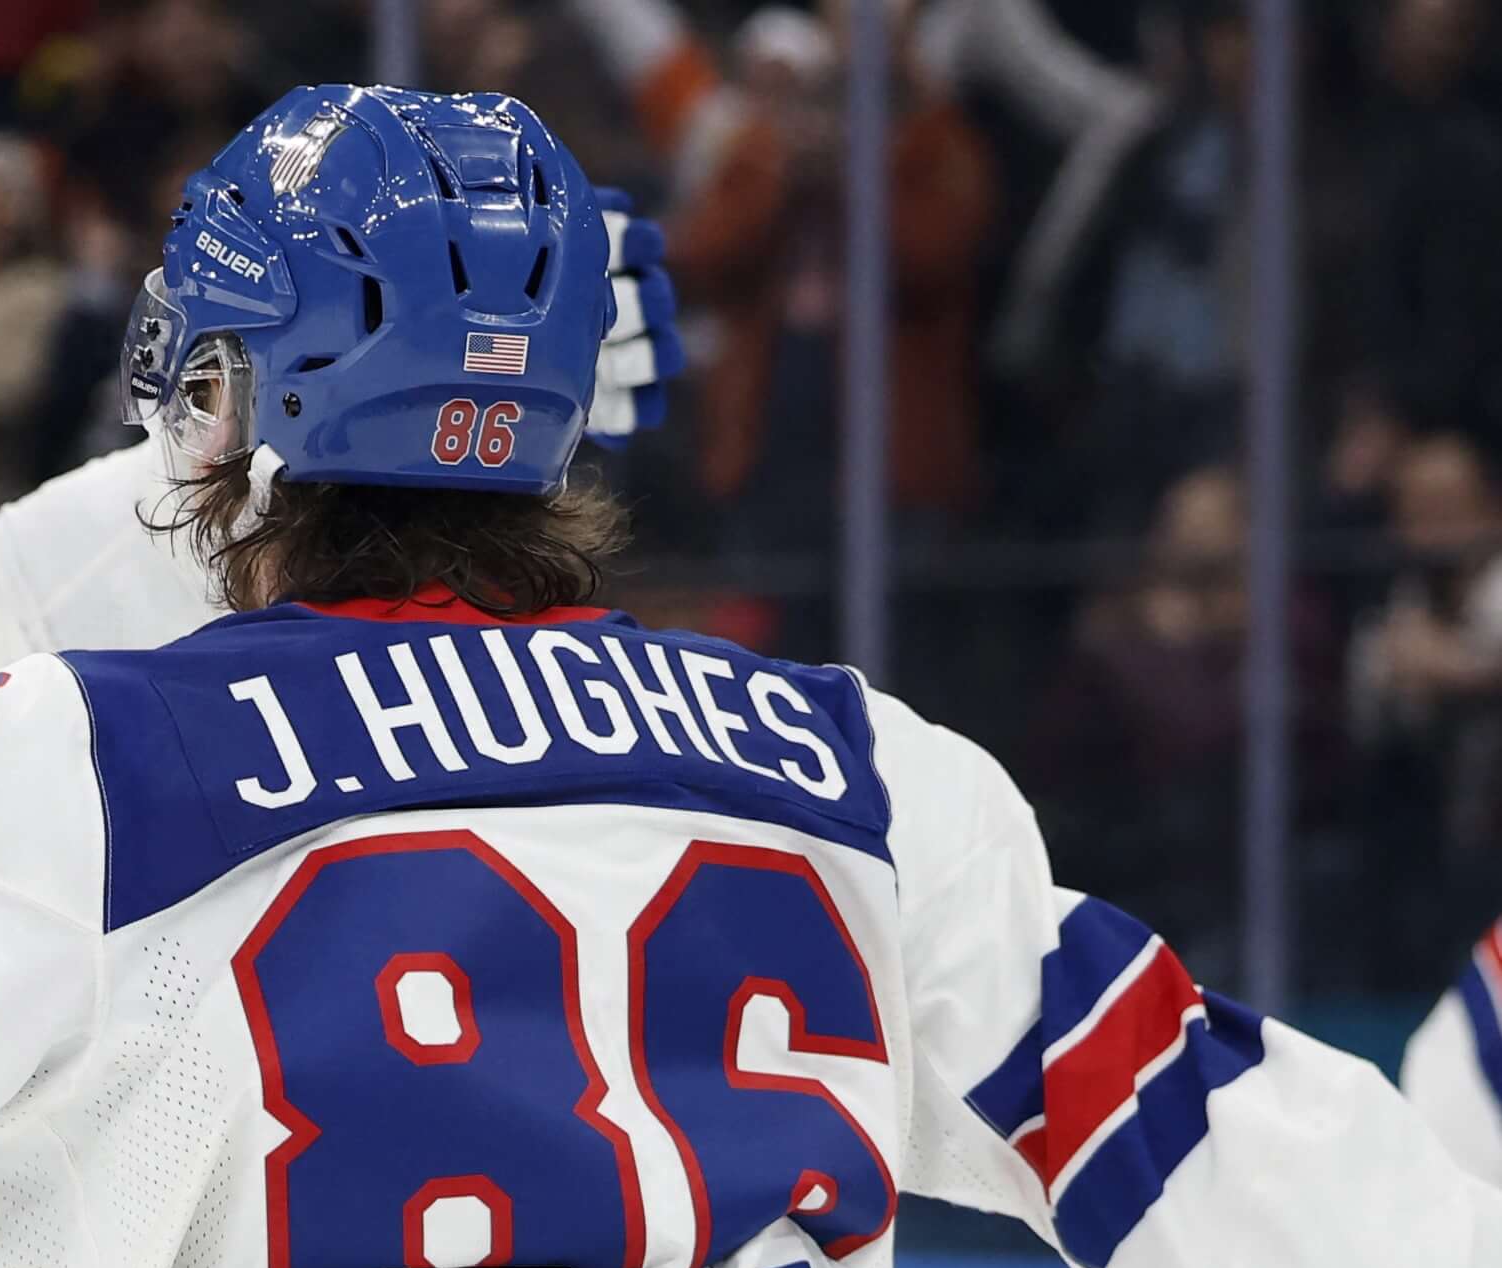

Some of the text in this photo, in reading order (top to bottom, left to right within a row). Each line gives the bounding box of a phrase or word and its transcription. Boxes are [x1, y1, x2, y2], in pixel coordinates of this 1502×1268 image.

[195, 230, 266, 284] BAUER
[131, 376, 162, 396] BAUER
[431, 398, 521, 467] 86
[227, 628, 848, 810] J.HUGHES
